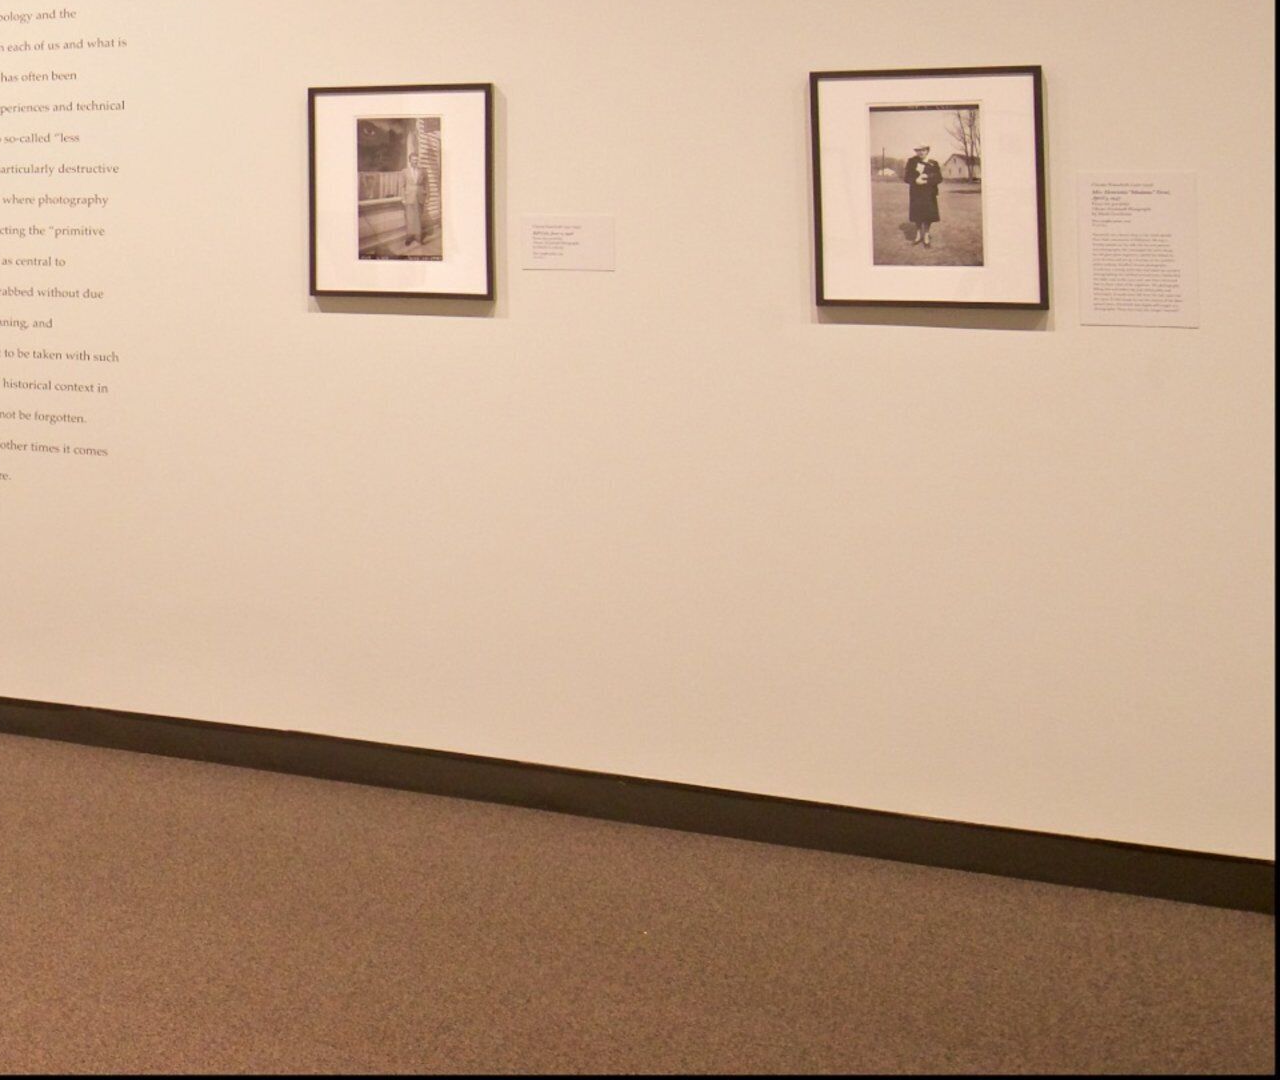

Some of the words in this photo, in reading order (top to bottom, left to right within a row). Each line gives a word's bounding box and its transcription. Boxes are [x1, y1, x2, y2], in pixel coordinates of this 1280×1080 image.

[36, 9, 56, 20] and
[59, 8, 76, 18] the
[7, 41, 31, 52] each
[34, 40, 44, 50] of
[63, 39, 83, 49] and
[87, 37, 114, 48] what
[118, 37, 127, 47] is
[1, 72, 19, 82] has
[21, 71, 48, 82] often
[51, 70, 77, 81] been
[53, 101, 73, 112] and
[77, 100, 125, 111] technical
[4, 133, 51, 144] so-called
[58, 163, 119, 174] destructive
[2, 194, 35, 204] where
[38, 194, 108, 208] photography
[29, 225, 45, 236] the
[15, 256, 51, 267] central
[55, 258, 66, 266] to
[37, 287, 79, 298] without
[82, 288, 104, 299] due
[4, 349, 15, 358] to
[17, 348, 30, 359] be
[33, 349, 62, 360] taken
[66, 350, 90, 361] with
[93, 351, 119, 362] such
[2, 378, 51, 390] historical
[54, 383, 94, 392] context
